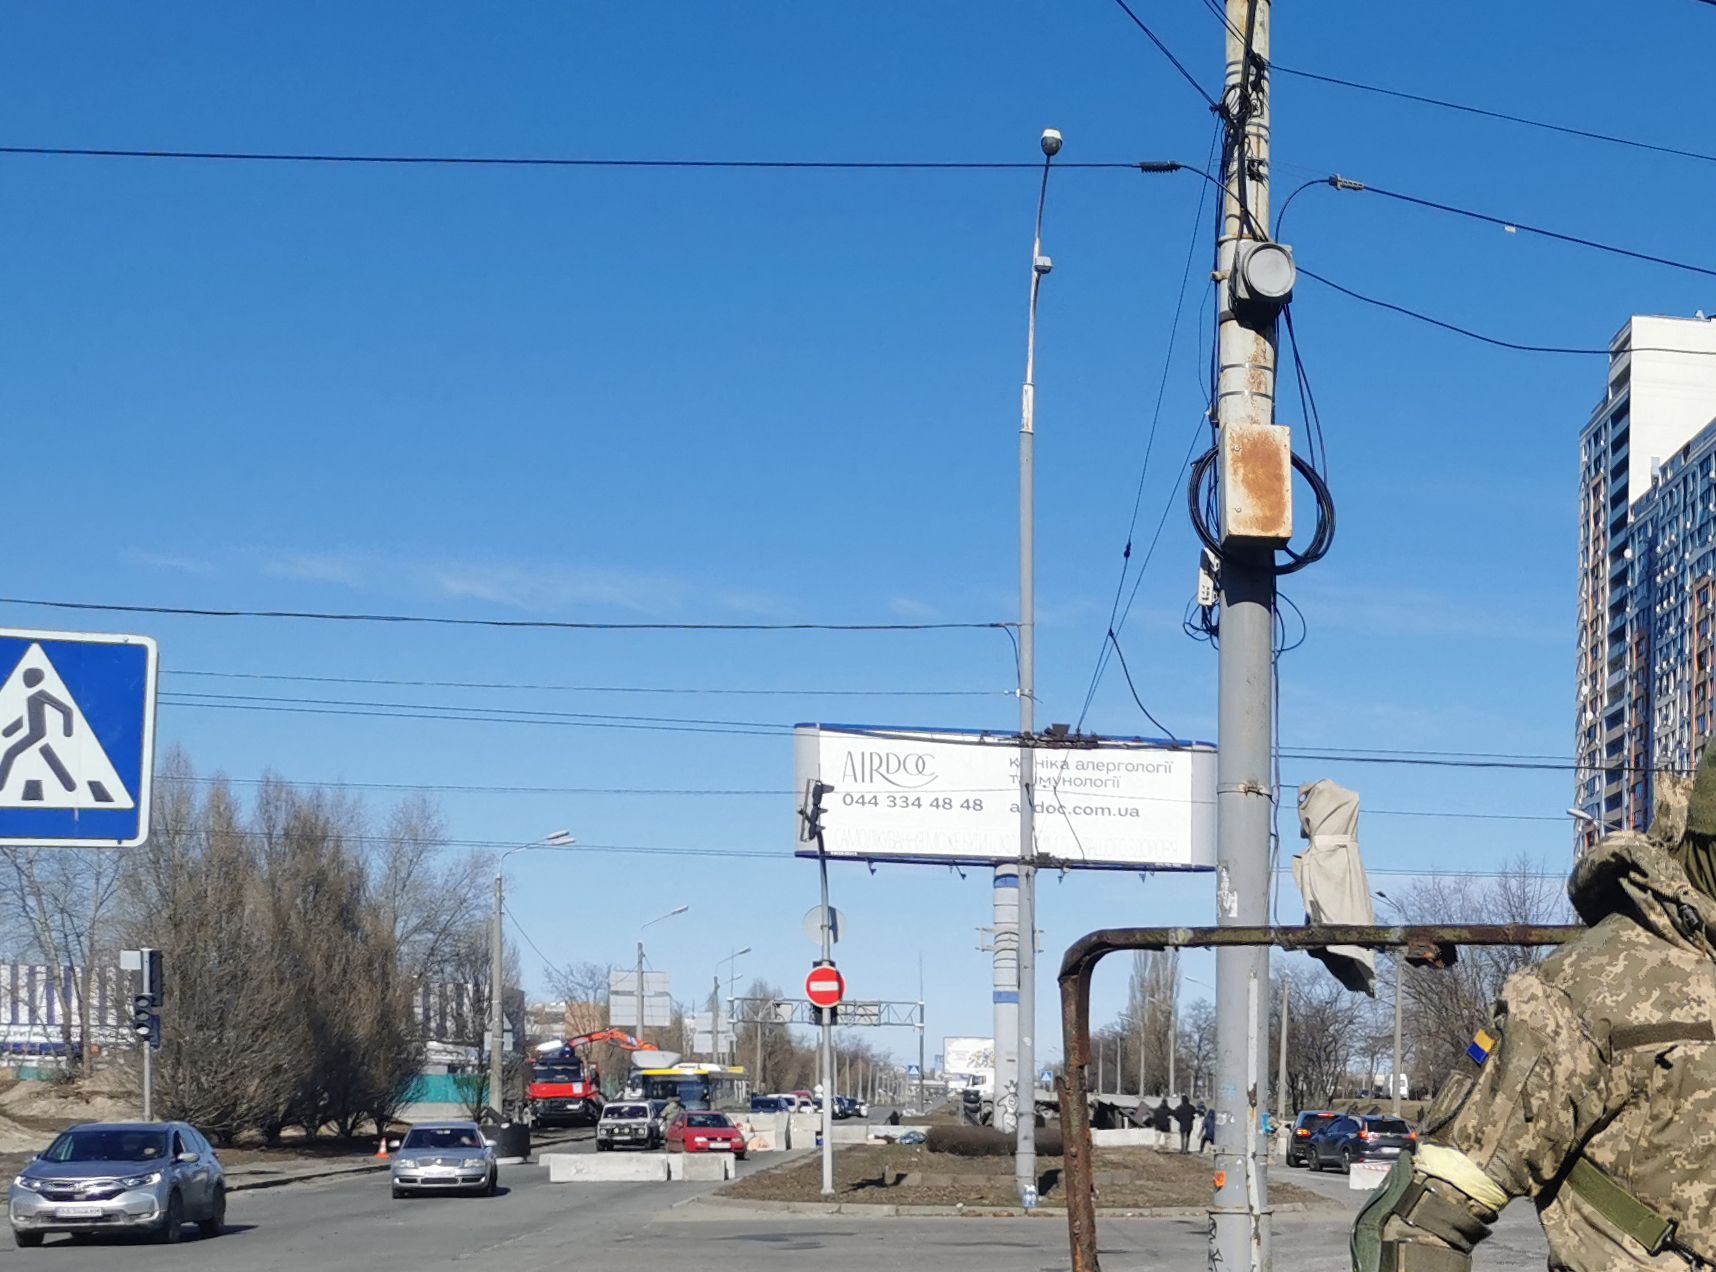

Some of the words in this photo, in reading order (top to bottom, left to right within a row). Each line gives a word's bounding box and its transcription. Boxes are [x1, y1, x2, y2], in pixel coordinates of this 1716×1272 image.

[842, 751, 939, 789] AIRDOC
[1009, 757, 1070, 771] кніка
[1075, 759, 1174, 775] алергології
[842, 793, 879, 807] 044
[886, 795, 923, 809] 334
[929, 797, 954, 811] 48
[960, 798, 984, 812] 48
[1009, 801, 1140, 817] adoc.com.ua
